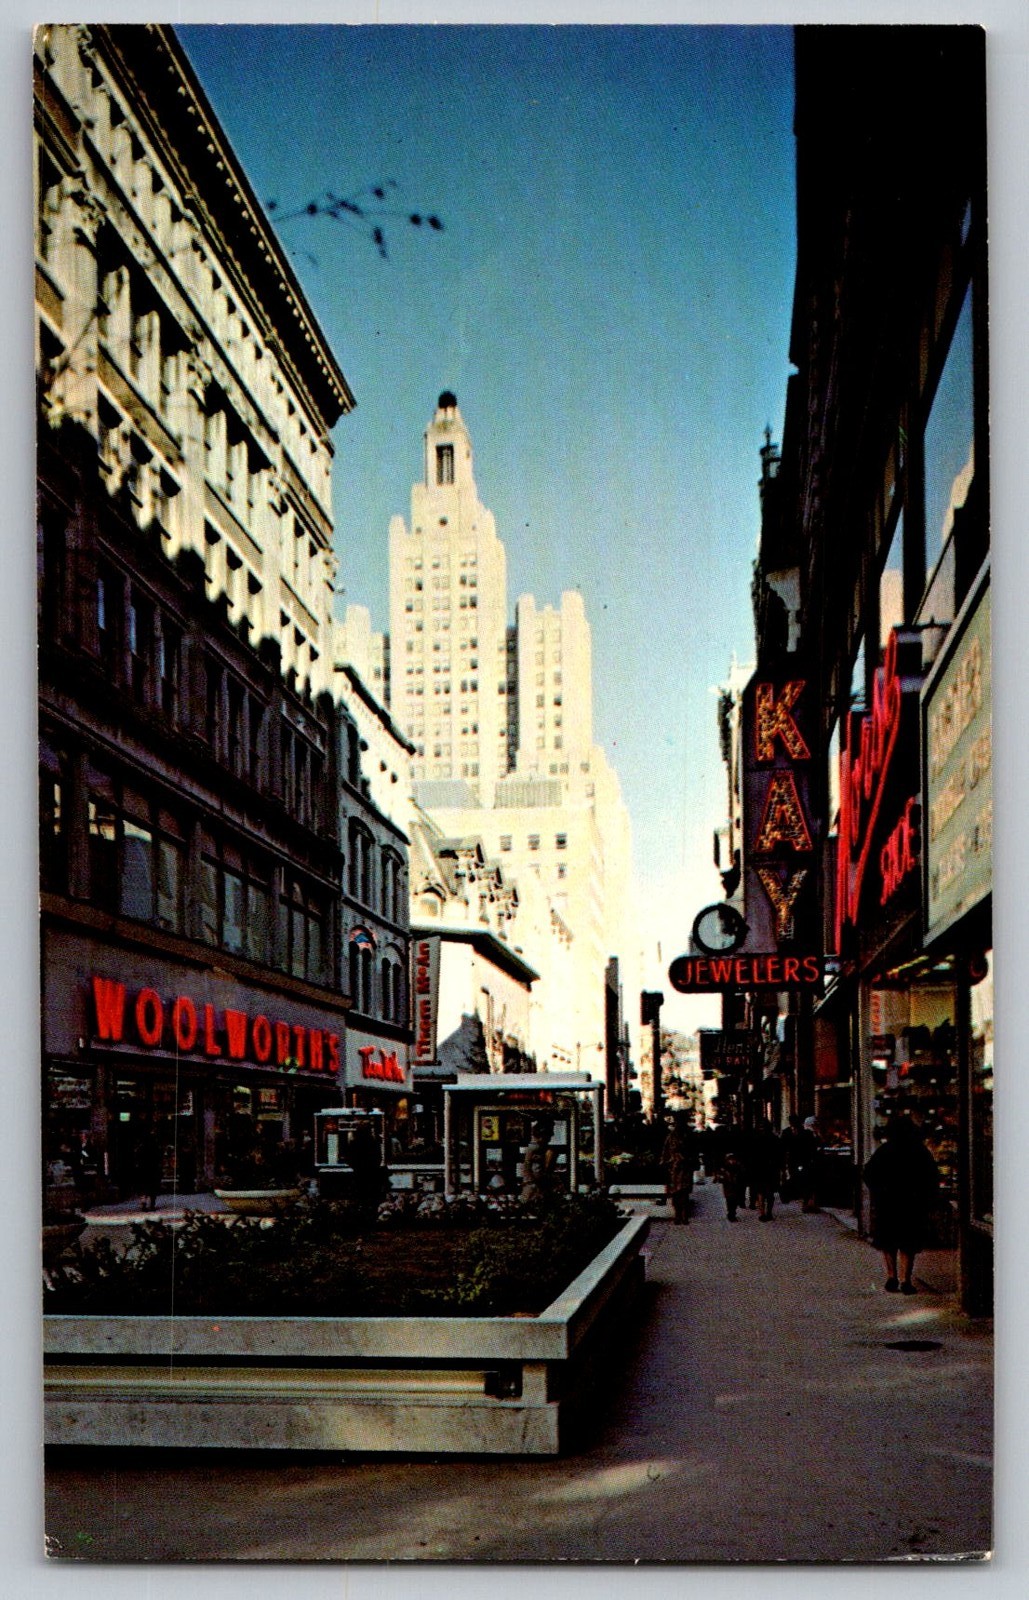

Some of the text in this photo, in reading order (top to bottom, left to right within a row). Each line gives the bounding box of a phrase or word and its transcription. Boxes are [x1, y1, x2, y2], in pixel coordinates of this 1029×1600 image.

[756, 680, 813, 942] KAY
[416, 942, 431, 1057] Thom McAn
[678, 956, 820, 986] JEWELERS
[93, 976, 341, 1072] WOOLWORTH'S
